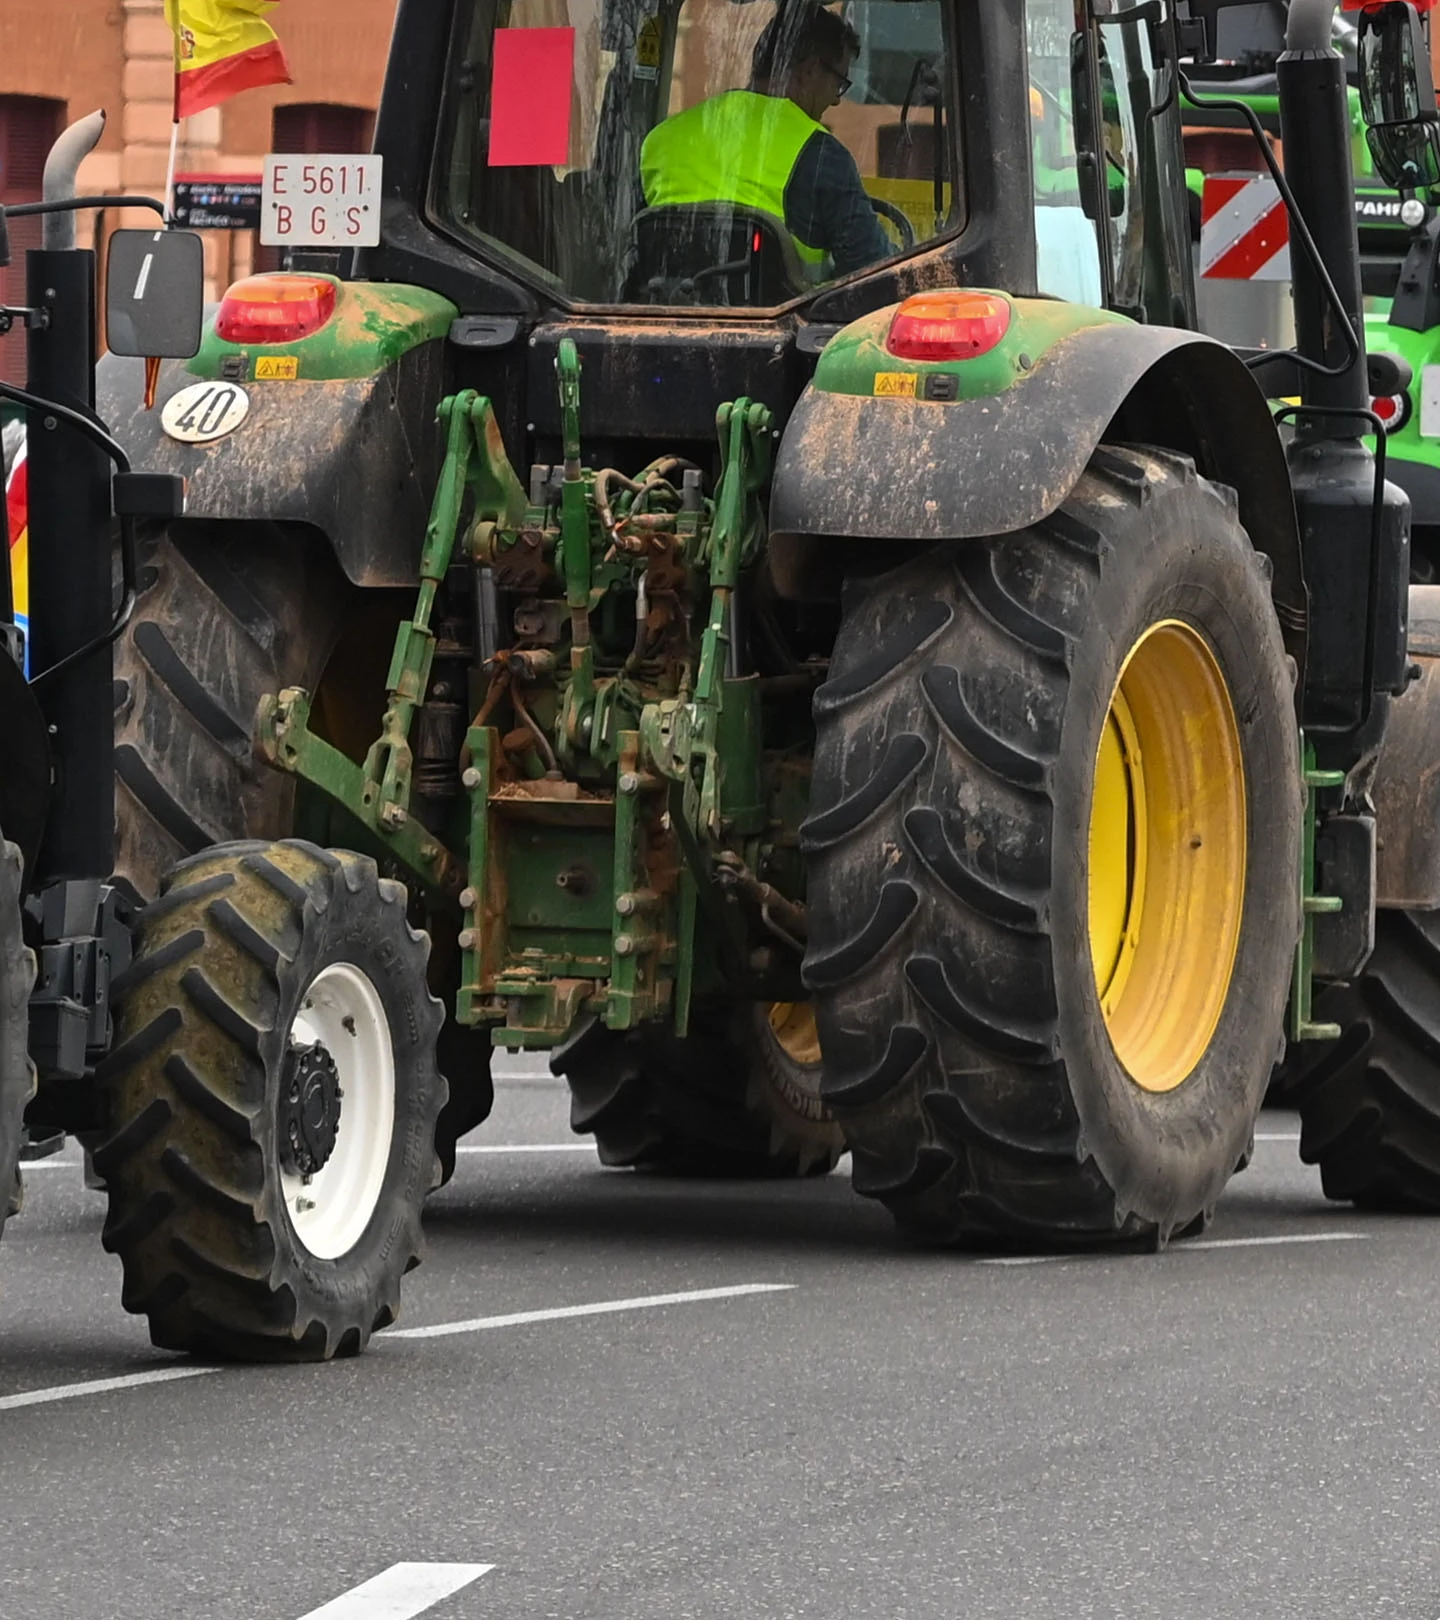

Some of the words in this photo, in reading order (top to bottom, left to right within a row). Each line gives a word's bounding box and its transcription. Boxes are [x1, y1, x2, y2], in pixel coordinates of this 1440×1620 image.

[273, 166, 288, 194] E
[303, 166, 364, 195] 5611
[175, 387, 237, 434] 40
